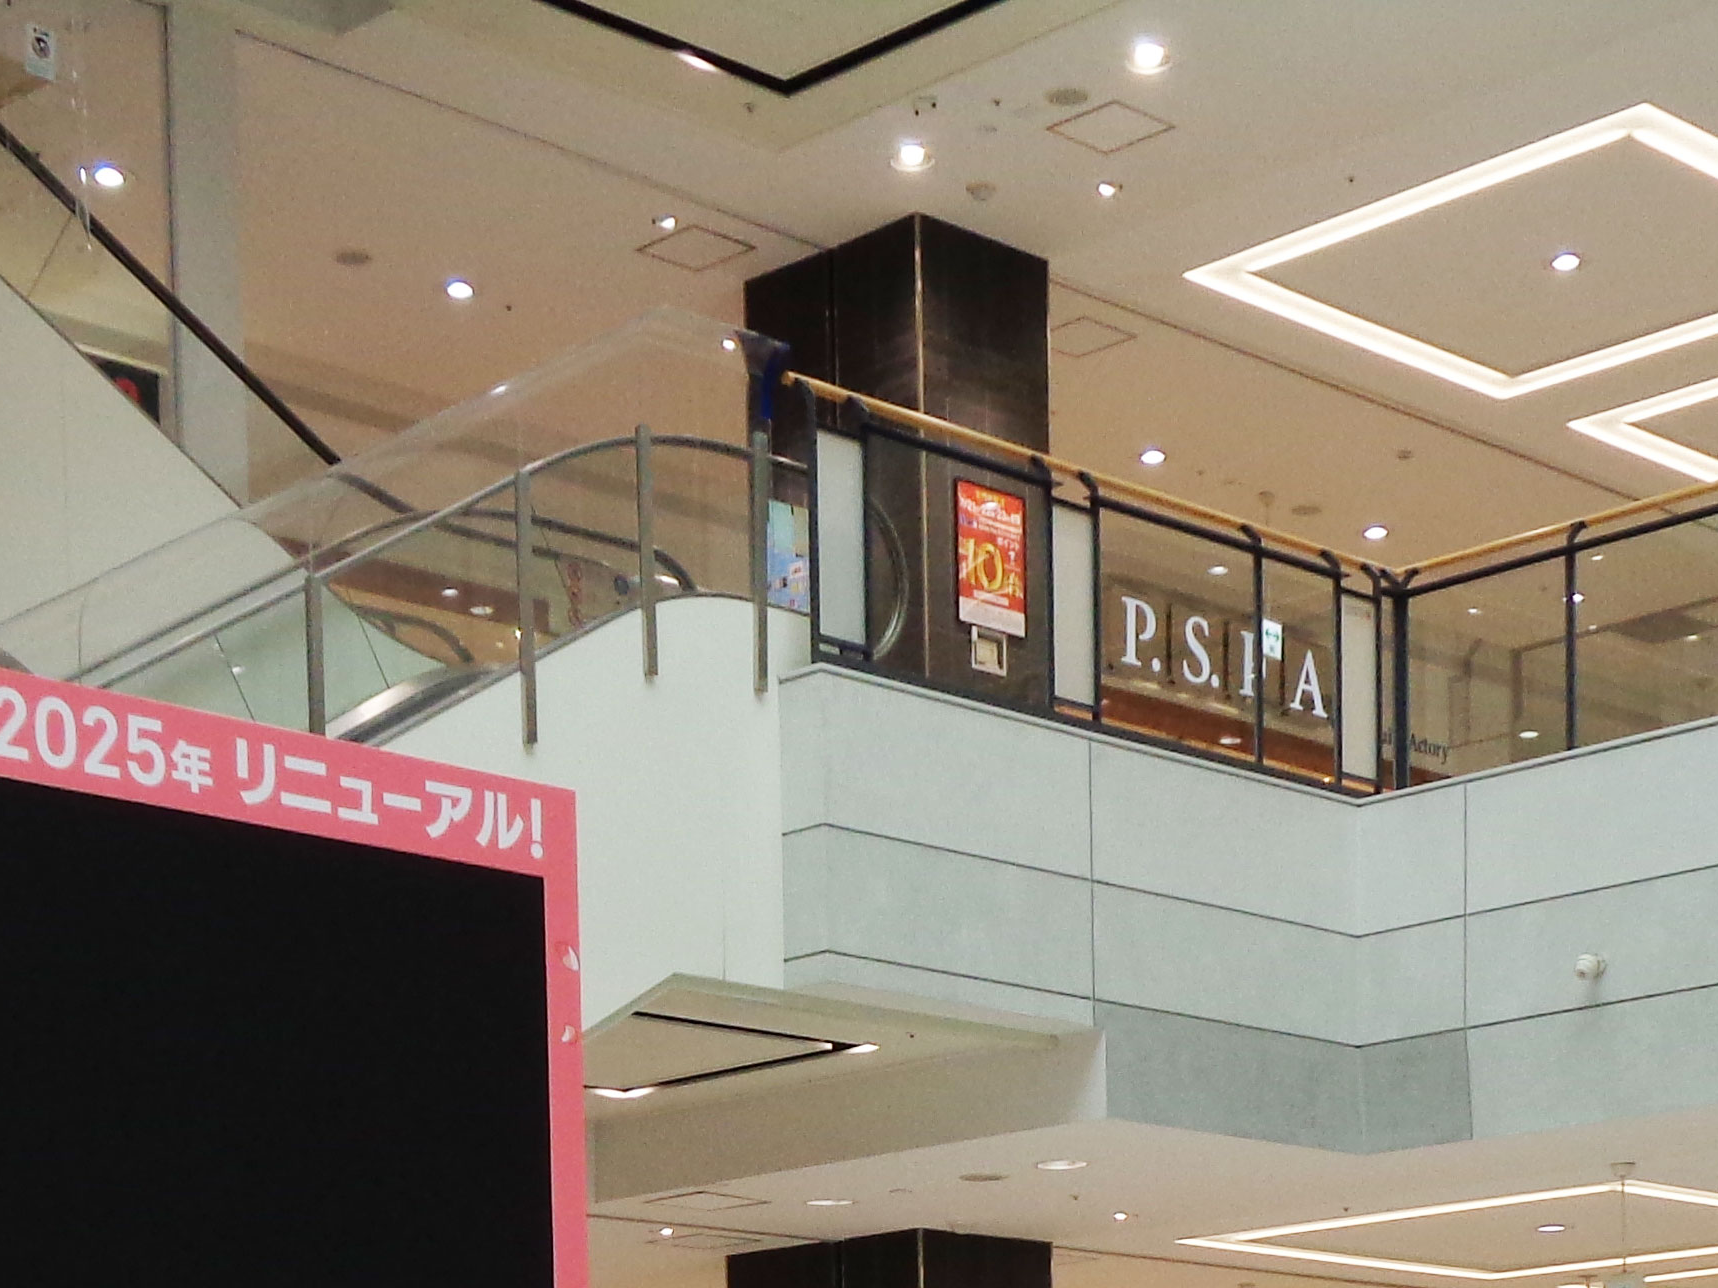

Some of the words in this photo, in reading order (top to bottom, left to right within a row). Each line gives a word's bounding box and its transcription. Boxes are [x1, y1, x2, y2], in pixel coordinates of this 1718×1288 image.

[235, 736, 545, 859] リニューアル!
